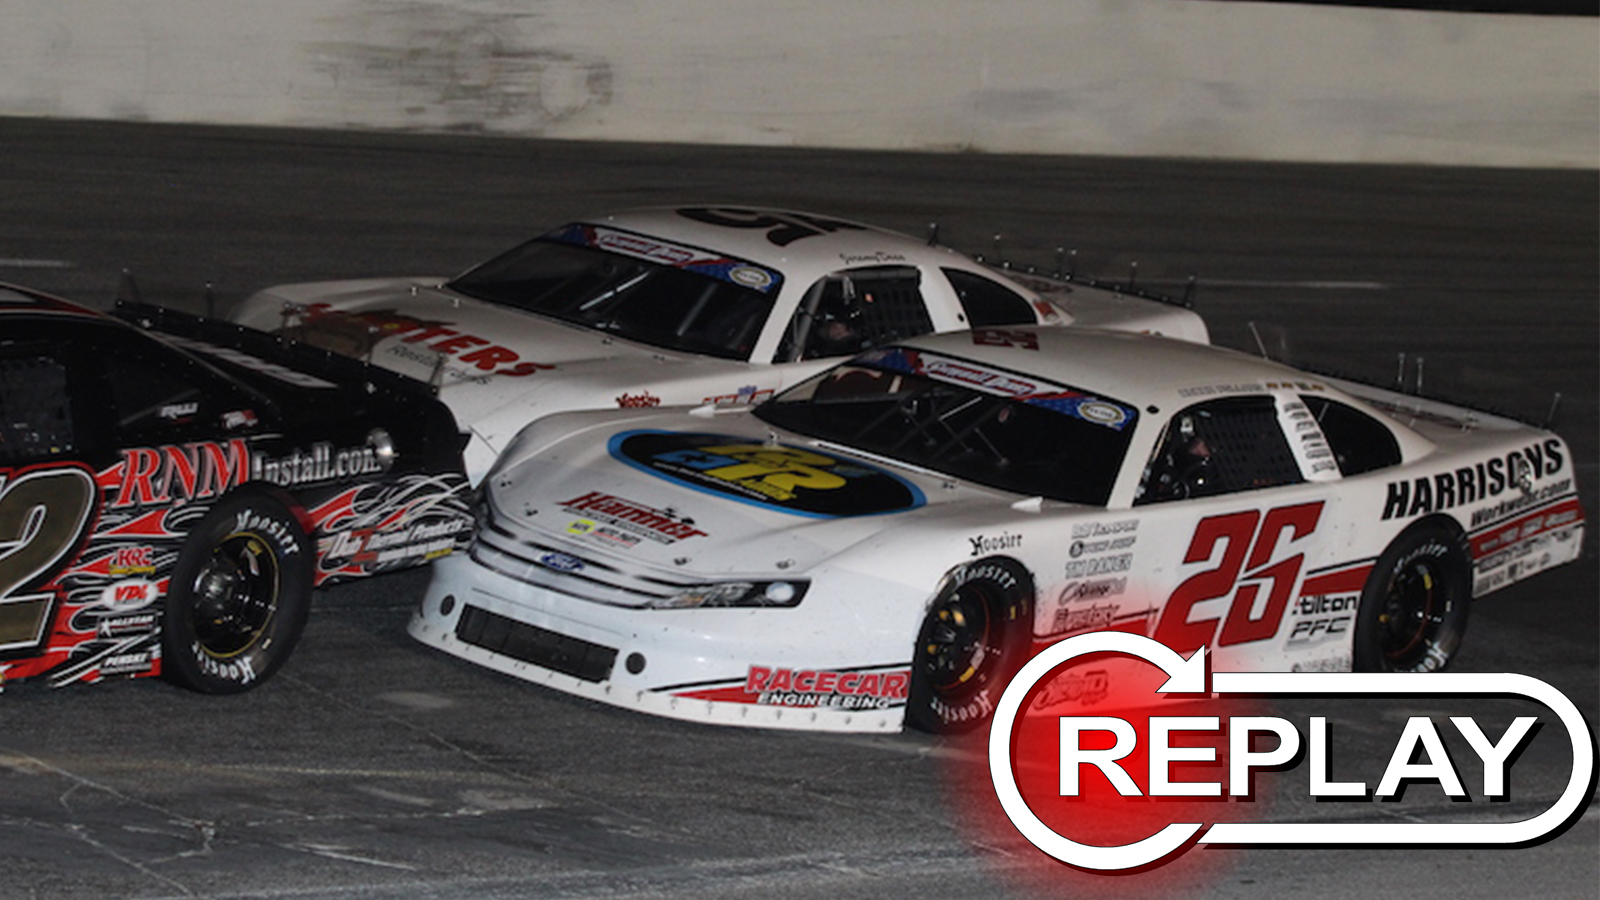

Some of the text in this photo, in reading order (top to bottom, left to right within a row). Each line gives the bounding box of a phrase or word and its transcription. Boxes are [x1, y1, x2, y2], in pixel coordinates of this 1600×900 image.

[109, 438, 250, 508] RNM
[230, 510, 300, 555] Hoosier
[968, 531, 1023, 556] Hoosier
[954, 564, 1018, 590] Hoosier
[1300, 595, 1357, 616] tilton
[1291, 617, 1351, 638] PFC
[745, 665, 909, 699] RACECAR
[757, 692, 889, 710] ENGINEERING
